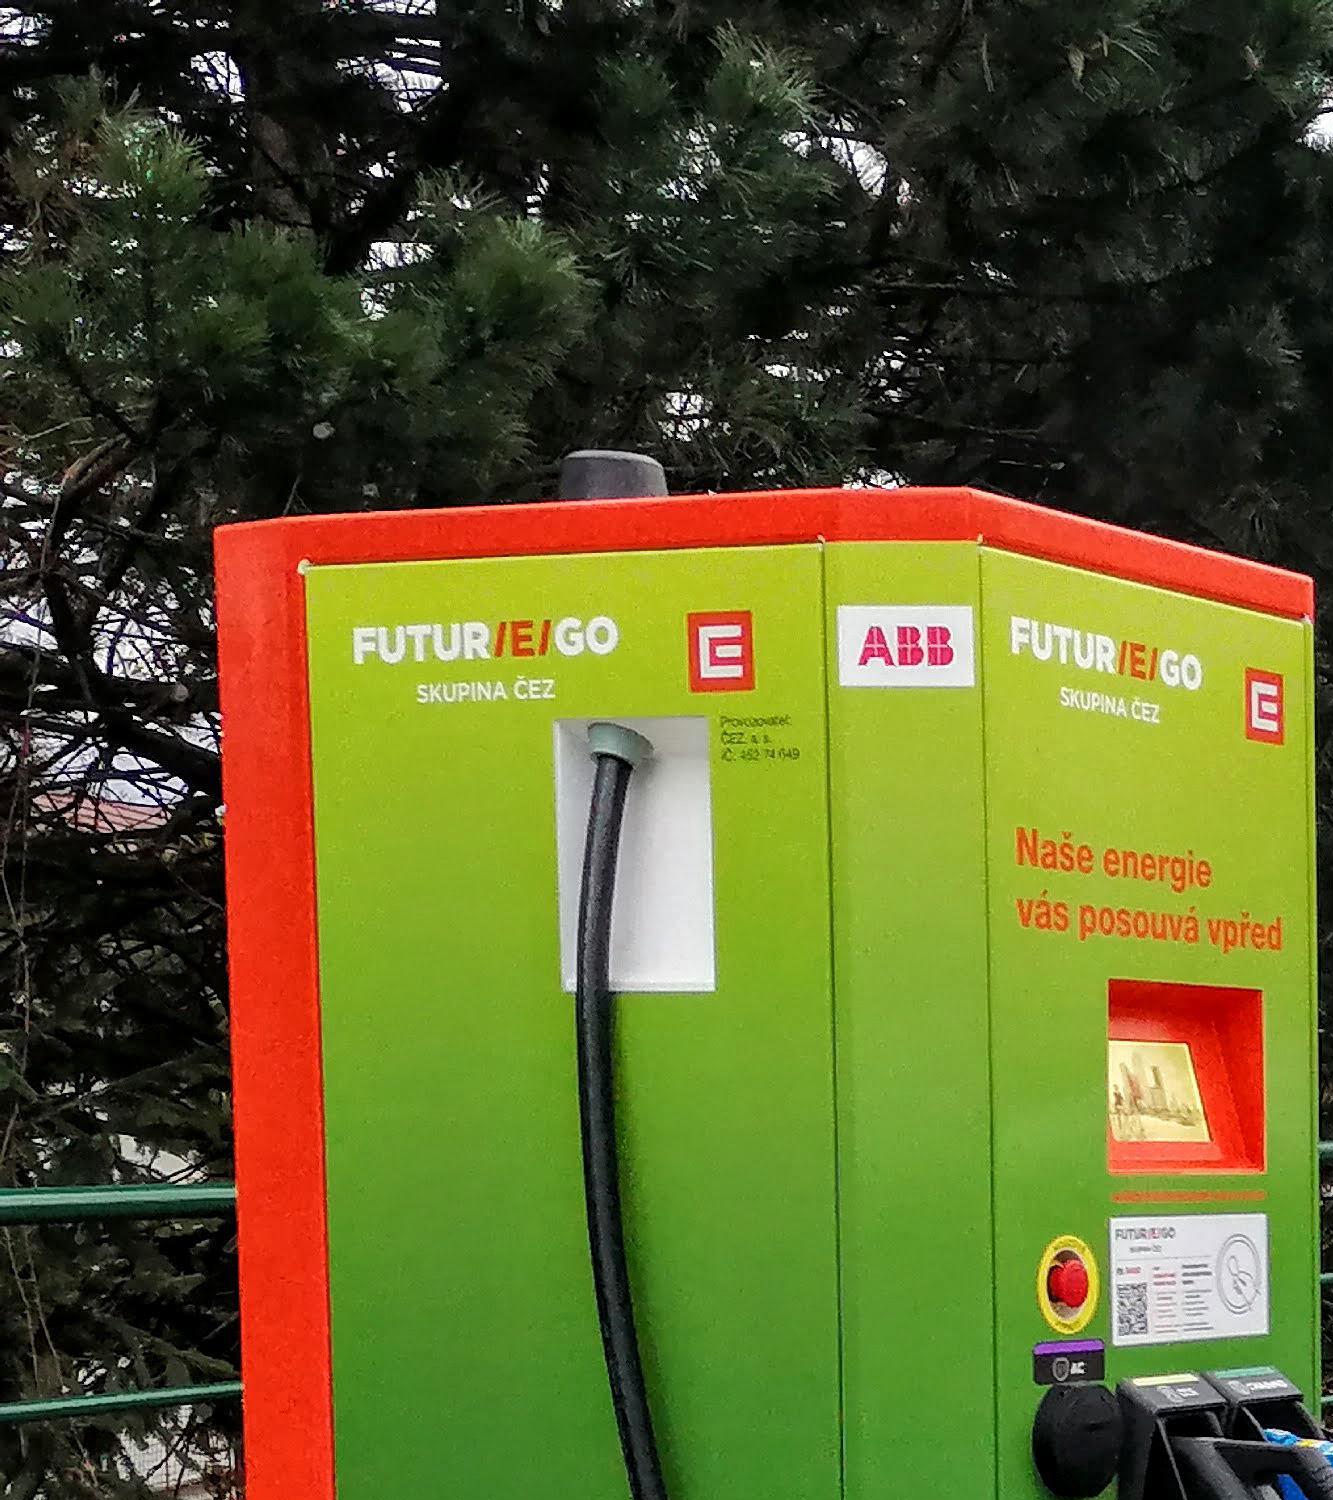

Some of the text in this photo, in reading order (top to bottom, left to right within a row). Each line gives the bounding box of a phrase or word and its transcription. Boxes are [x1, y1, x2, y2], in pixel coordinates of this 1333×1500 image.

[352, 617, 619, 665] FUTUR/E/GO
[858, 626, 954, 667] ABB
[1010, 616, 1203, 691] FUTUR/E/GO
[416, 675, 557, 704] SKUPINA ČEZ
[1059, 686, 1161, 725] SKUPINA ČEZ
[1015, 826, 1213, 894] Naše energie
[1015, 888, 1284, 955] vás posouvá vpřed
